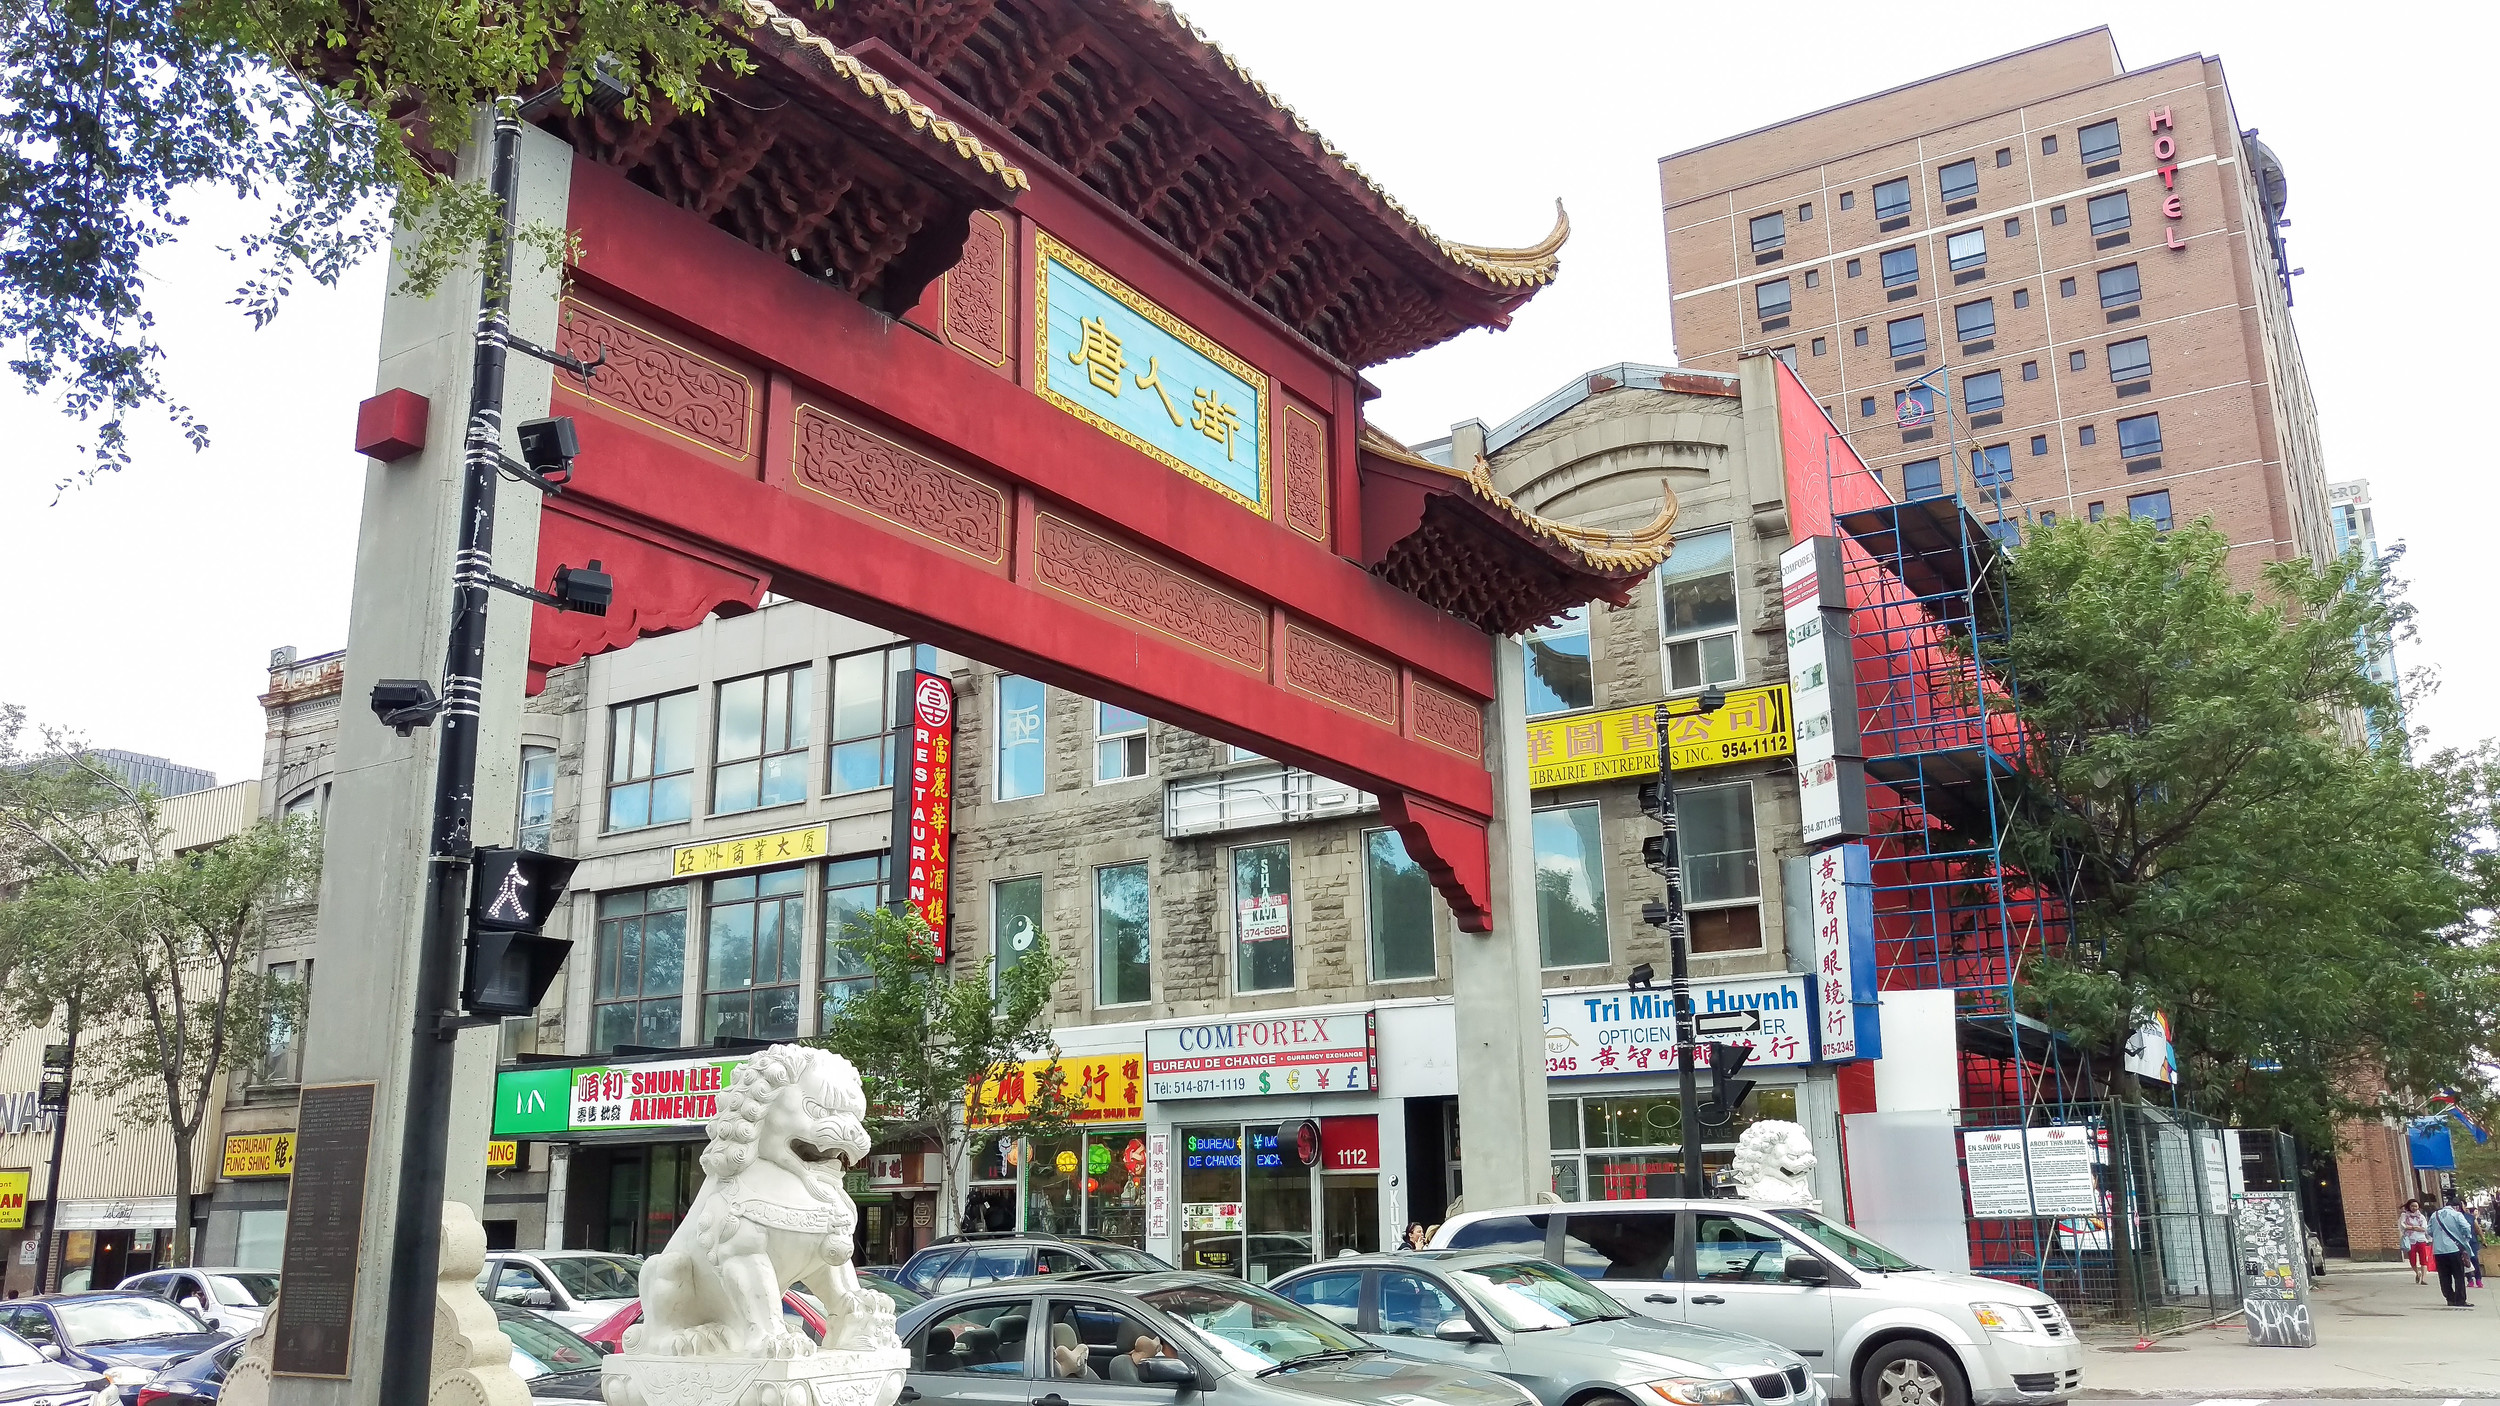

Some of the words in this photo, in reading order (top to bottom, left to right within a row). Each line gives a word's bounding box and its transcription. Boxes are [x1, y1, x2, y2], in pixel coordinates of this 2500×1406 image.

[2149, 105, 2186, 250] HOTEL
[1068, 316, 1241, 462] 唐人街
[1782, 552, 1816, 577] COMFOREX
[1529, 764, 1587, 786] IBRAIRIE
[1594, 752, 1679, 776] ENTREPRIS
[1685, 746, 1714, 763] INC.
[1721, 735, 1788, 759] 954-1112
[910, 728, 930, 912] RESTAURAN
[927, 734, 949, 926] 富麗華大酒樓
[1803, 815, 1841, 836] 514.871.1119
[1244, 924, 1287, 938] 374-6620
[1584, 997, 1619, 1022] Tri
[1707, 985, 1798, 1013] Huynh
[1179, 1017, 1331, 1052] COMFOREX
[1599, 1026, 1671, 1046] OPTICIEN
[1823, 1040, 1854, 1056] 875-2345
[1153, 1059, 1201, 1072] BUREAU
[1205, 1058, 1221, 1068] DE
[1225, 1054, 1277, 1067] CHANGE
[1286, 1053, 1324, 1061] CURRENCY
[1325, 1051, 1364, 1059] EXCHANGE
[578, 1070, 624, 1103] 順利
[631, 1070, 685, 1095] SHUN
[689, 1067, 722, 1092] LEE
[1154, 1081, 1172, 1095] Tél:
[1174, 1077, 1245, 1094] 514-871-1119
[227, 1138, 272, 1154] RESTAURANT
[1197, 1138, 1235, 1150] BUREAU
[225, 1156, 245, 1172] FUNG
[248, 1155, 271, 1171] SHING
[1188, 1155, 1203, 1167] DE
[1337, 1148, 1368, 1165] 1112
[1152, 1141, 1165, 1229] 順發檀香莊
